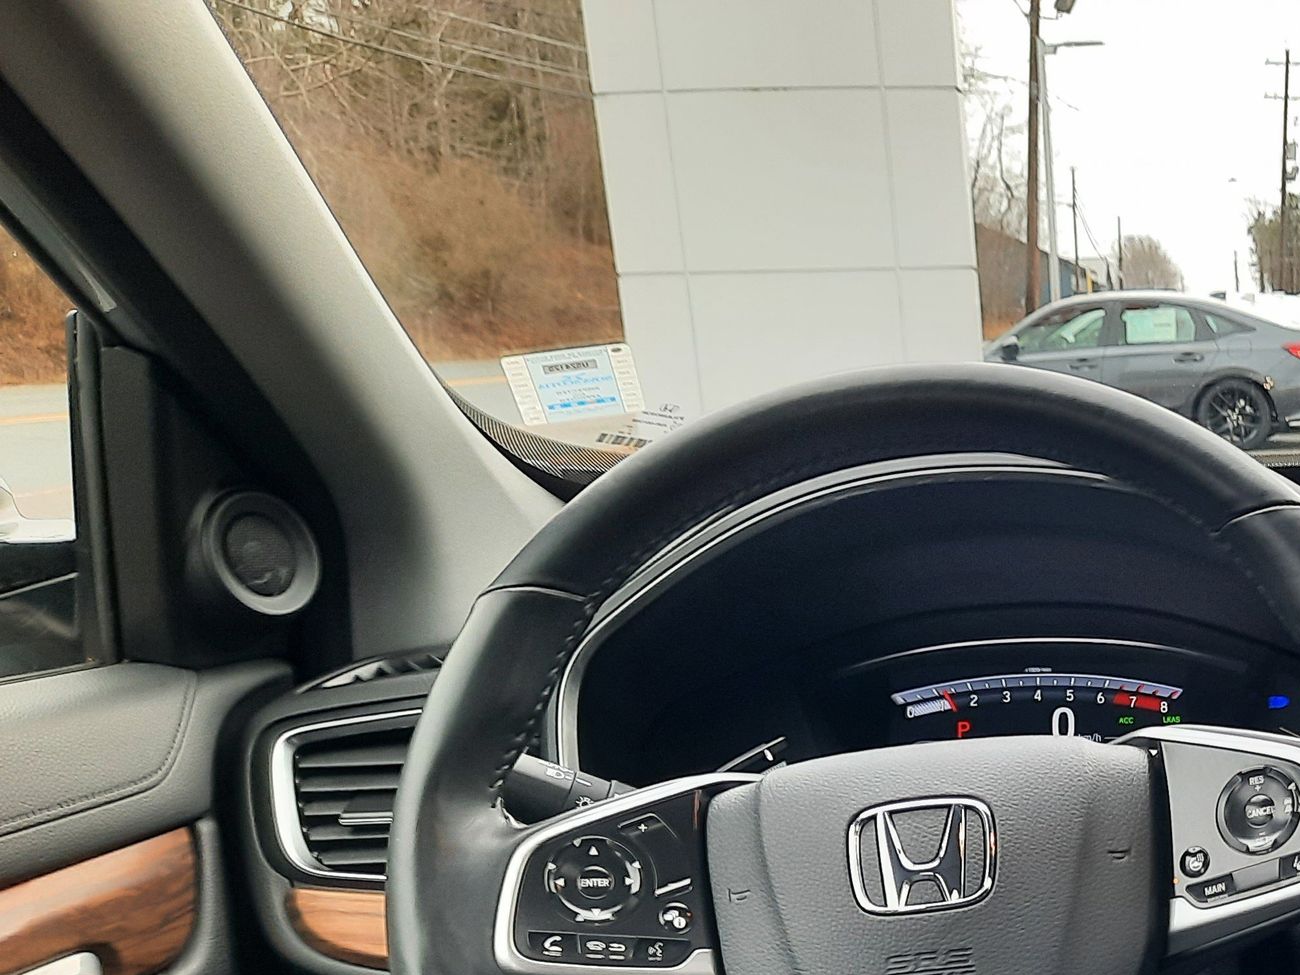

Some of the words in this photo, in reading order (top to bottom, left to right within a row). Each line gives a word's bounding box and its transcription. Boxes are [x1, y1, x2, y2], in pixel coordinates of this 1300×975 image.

[969, 695, 978, 706] 2
[1002, 691, 1011, 702] 3
[1034, 690, 1042, 701] 4
[1066, 690, 1074, 701] 5
[1096, 692, 1105, 704] 6
[1129, 696, 1137, 708] 7
[1160, 701, 1168, 713] 8
[957, 721, 971, 738] P
[1052, 707, 1075, 737] 0
[1249, 775, 1265, 786] RES
[580, 878, 610, 887] ENTER
[1204, 883, 1226, 896] MAIN
